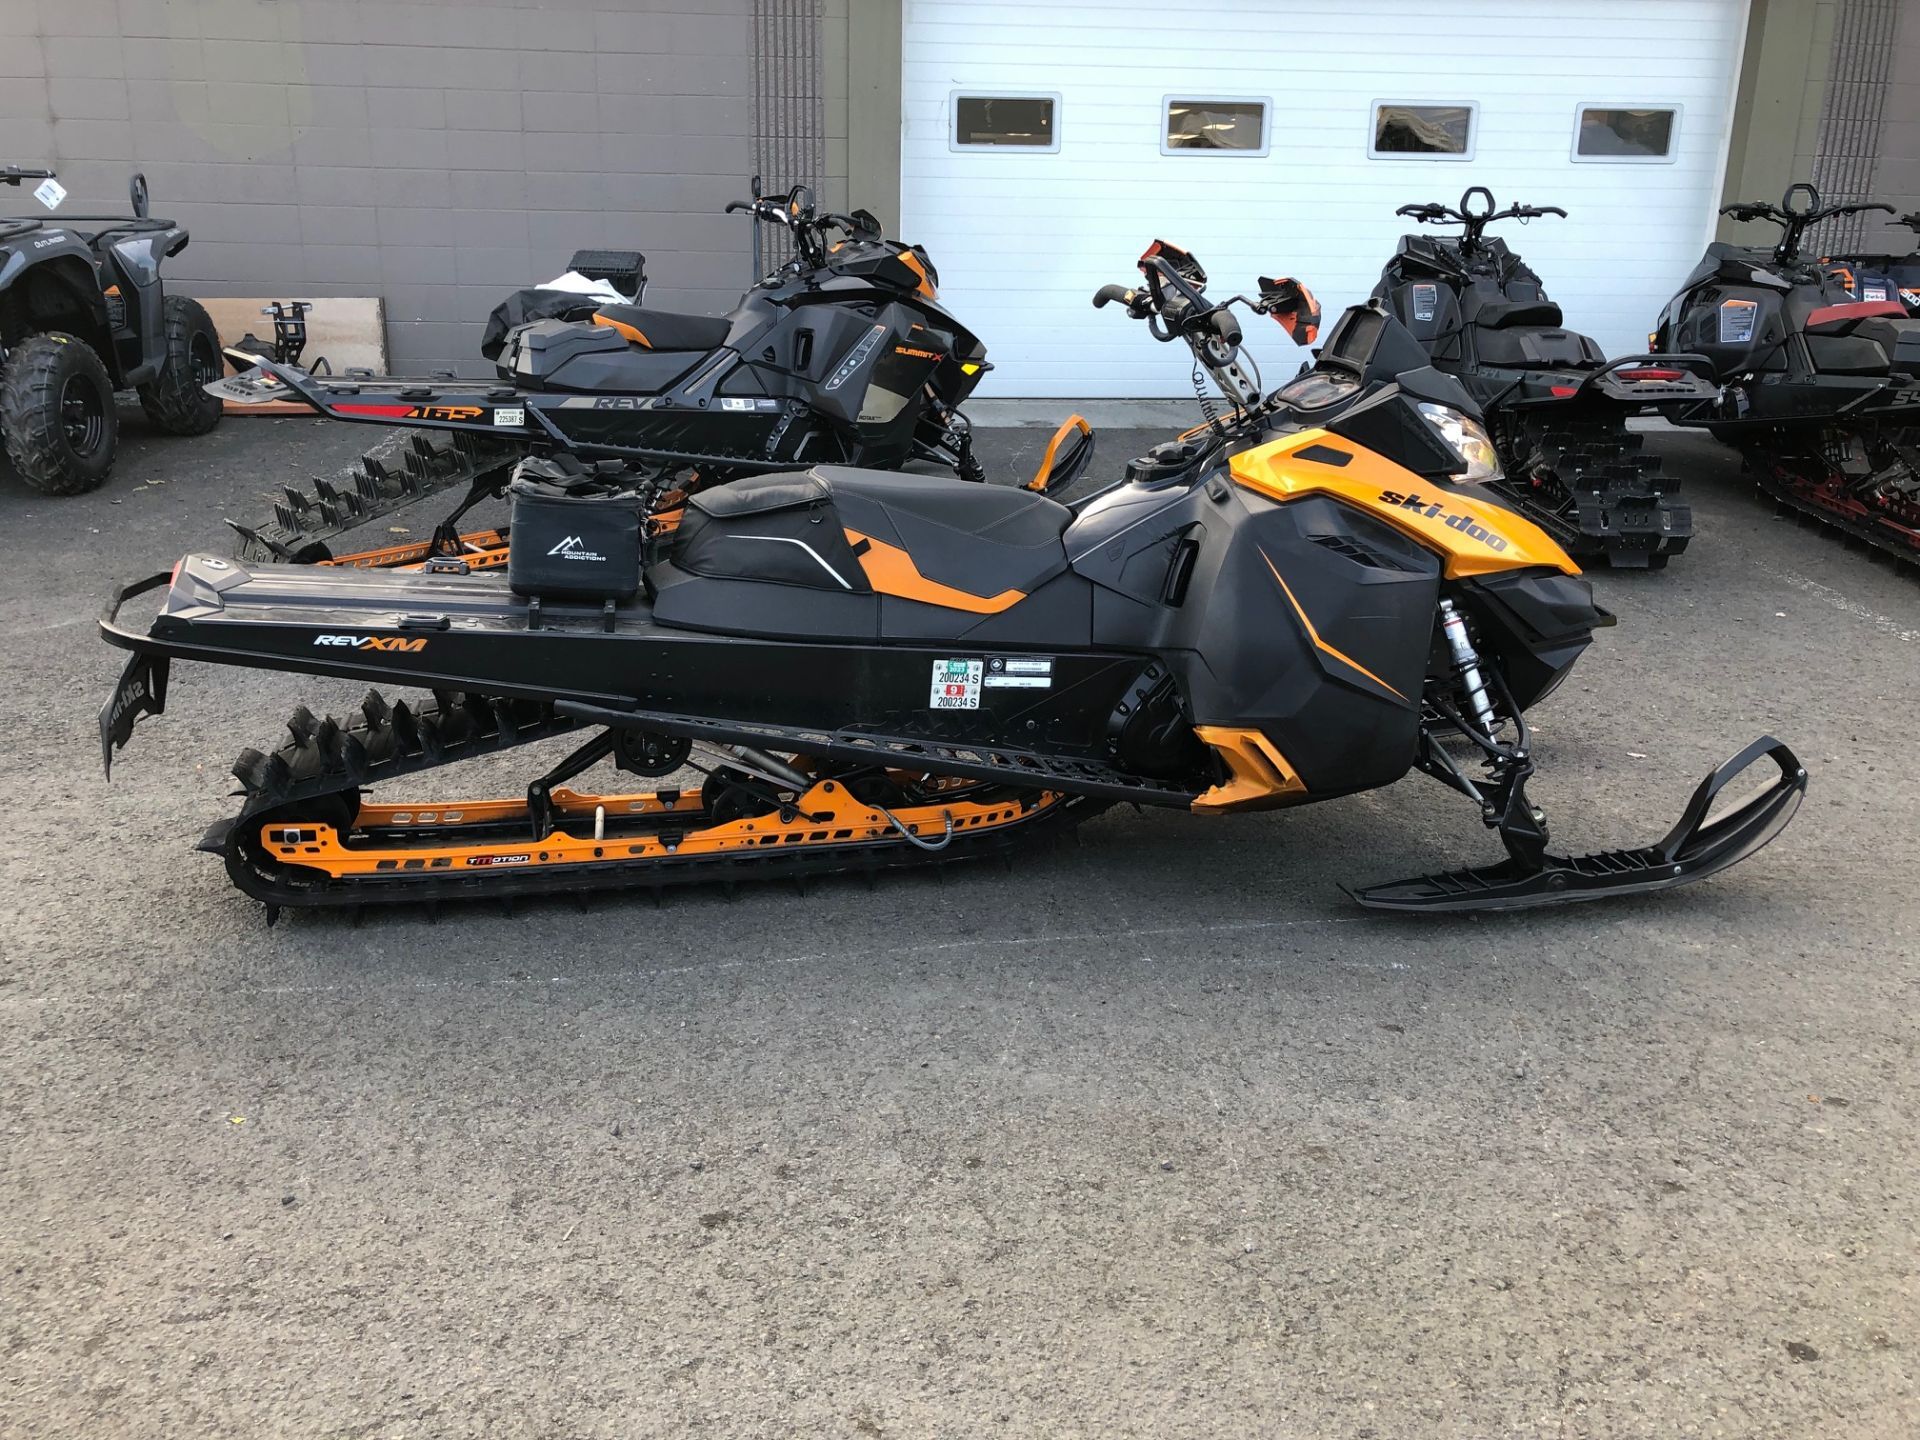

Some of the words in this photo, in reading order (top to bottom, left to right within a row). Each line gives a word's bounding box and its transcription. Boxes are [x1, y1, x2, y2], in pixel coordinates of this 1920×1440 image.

[1378, 490, 1508, 552] ski-doo
[938, 671, 970, 684] 200234
[971, 674, 980, 685] S
[950, 685, 958, 696] 9
[937, 696, 968, 708] 200234
[969, 698, 978, 708] S
